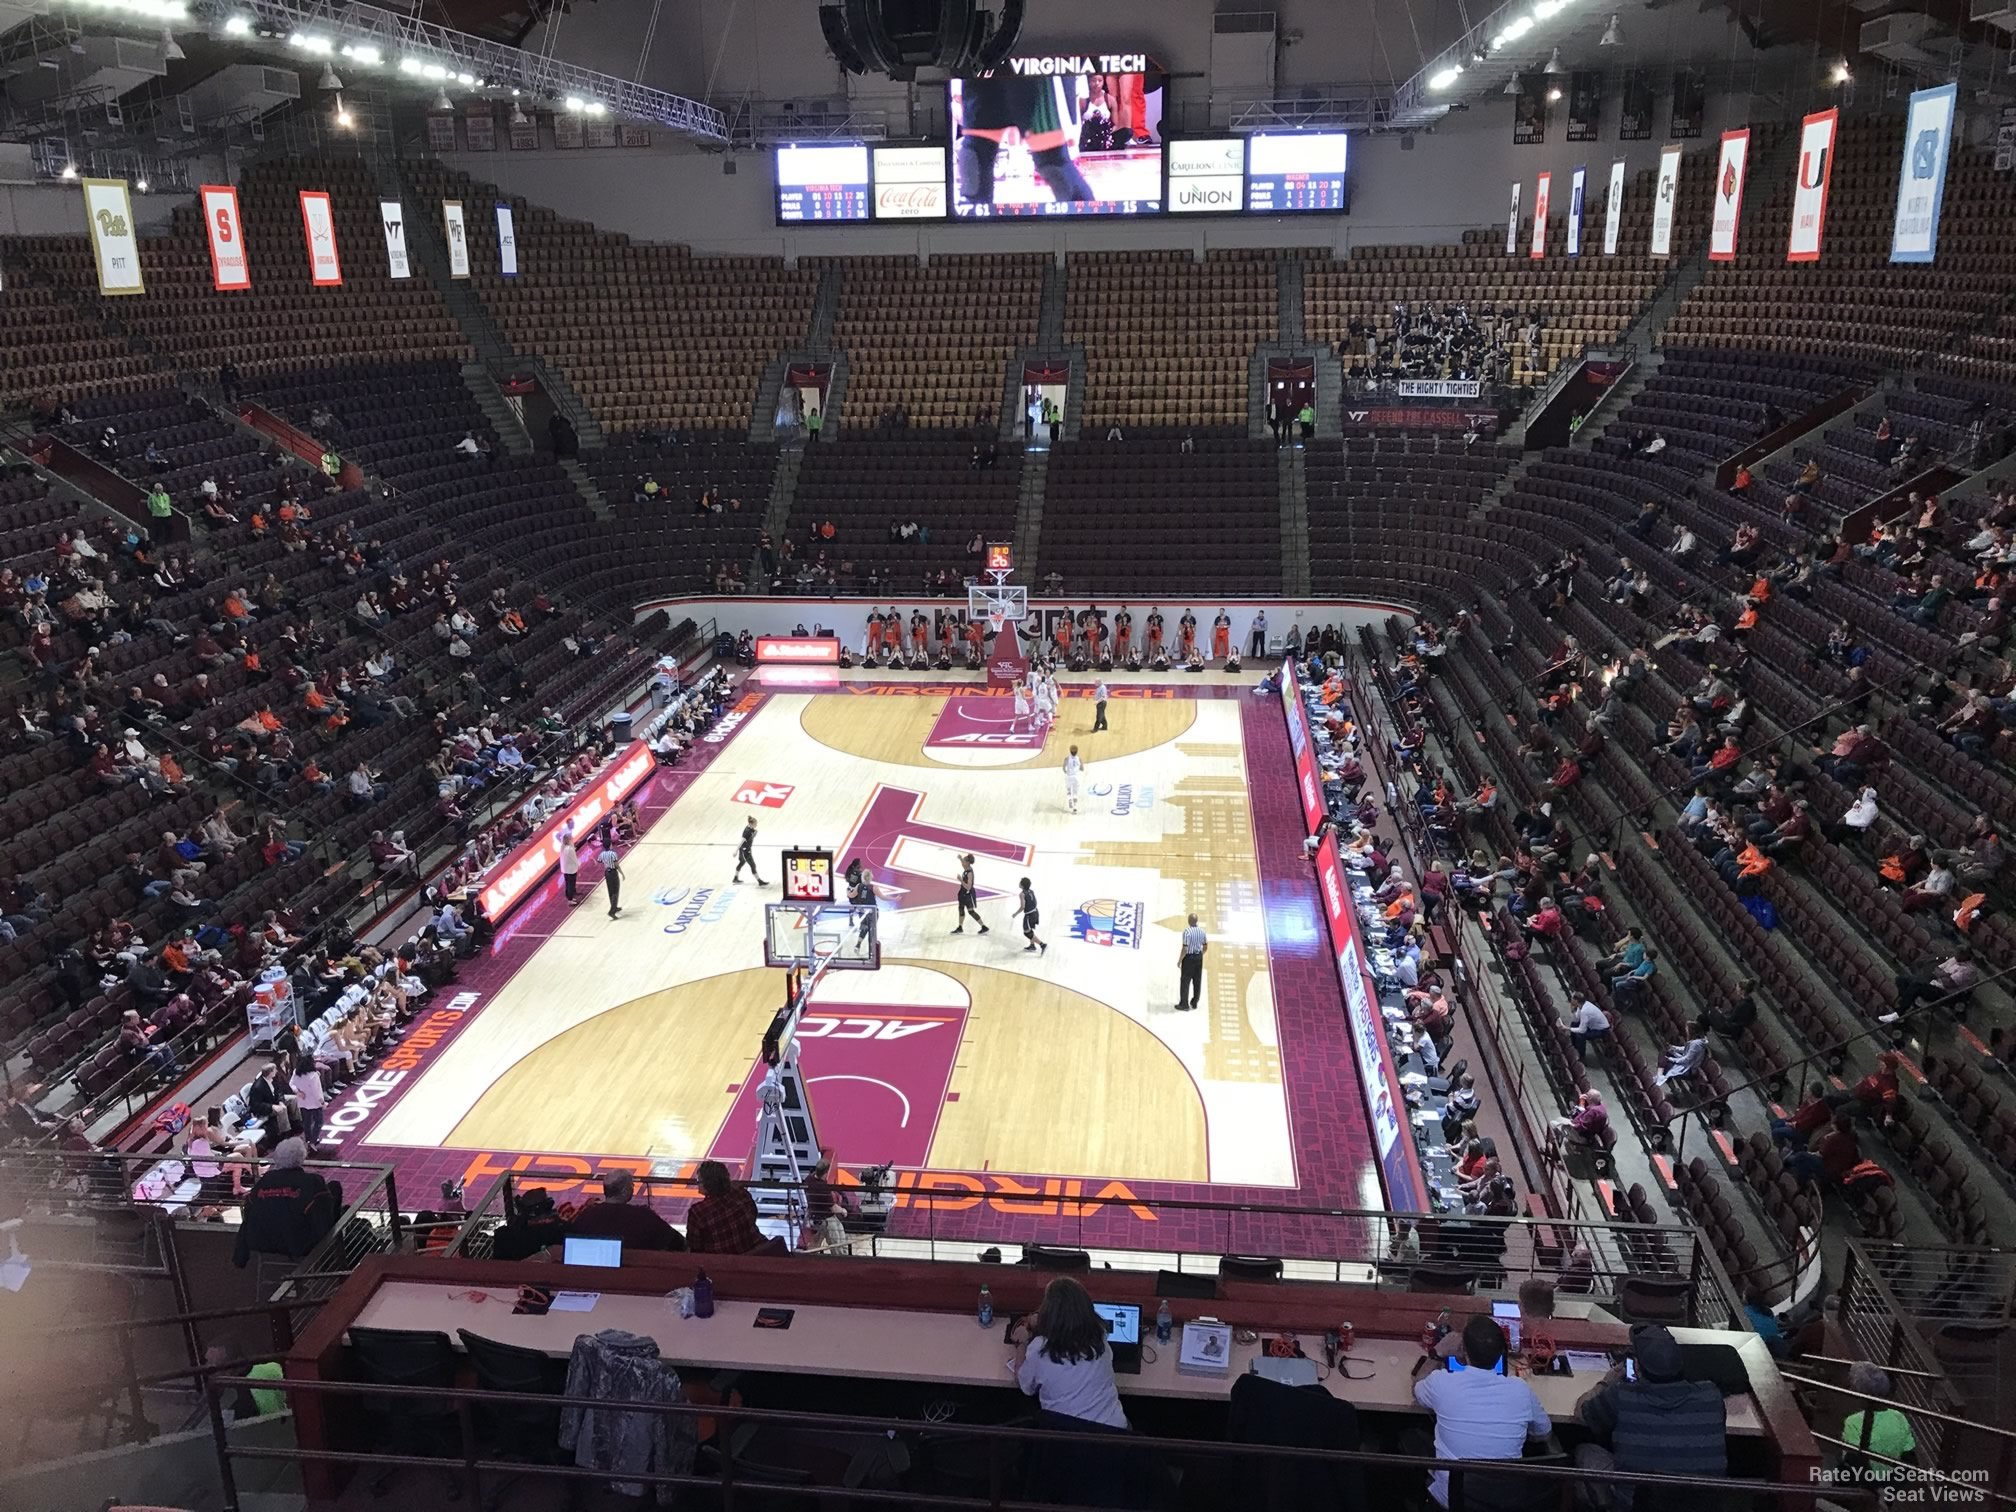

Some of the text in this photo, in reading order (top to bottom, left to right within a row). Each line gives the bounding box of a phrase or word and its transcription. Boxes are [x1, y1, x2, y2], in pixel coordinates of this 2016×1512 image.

[1010, 56, 1095, 75] VIRGINIA
[1099, 54, 1146, 73] TECH
[1800, 148, 1828, 189] U
[1180, 190, 1232, 204] UNION
[975, 204, 990, 216] 61
[1123, 201, 1137, 213] 15
[96, 208, 128, 237] Pitt
[216, 208, 232, 242] S
[385, 221, 401, 240] VT
[502, 236, 512, 244] ACC
[112, 257, 126, 270] PITT
[1401, 382, 1415, 394] THE
[1446, 383, 1478, 395] TIGHTIES
[1348, 411, 1368, 422] VT
[992, 556, 1007, 567] 26
[940, 733, 1038, 744] ACC
[736, 784, 793, 804] 2K
[1111, 784, 1135, 816] CARILION
[664, 887, 715, 934] CARILION
[1112, 900, 1136, 948] CLASSIC
[1086, 929, 1112, 946] 2K
[794, 1018, 944, 1040] ACC
